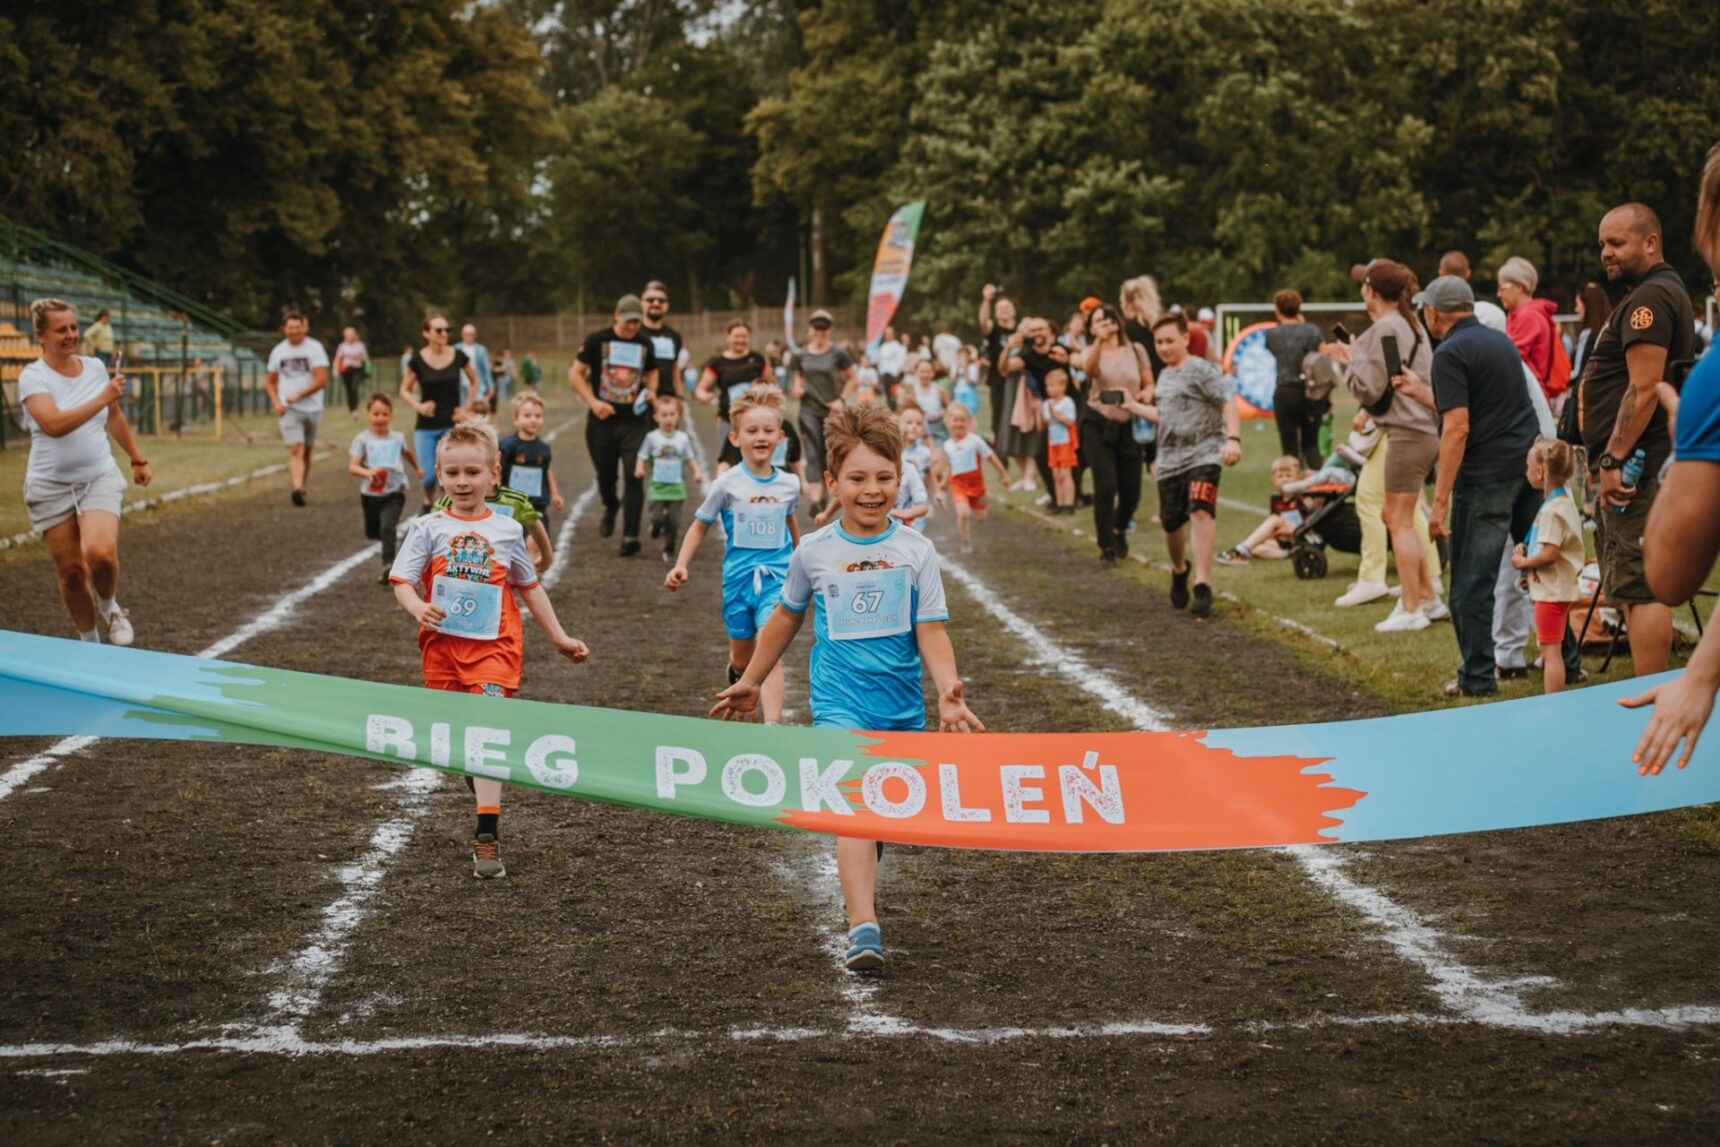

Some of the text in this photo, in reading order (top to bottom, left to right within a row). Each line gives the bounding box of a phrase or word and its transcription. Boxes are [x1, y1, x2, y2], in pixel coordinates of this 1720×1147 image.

[749, 521, 776, 535] 108
[450, 596, 478, 617] 69
[851, 590, 885, 614] 67
[366, 714, 1125, 825] BIEG POKOLEŃ
